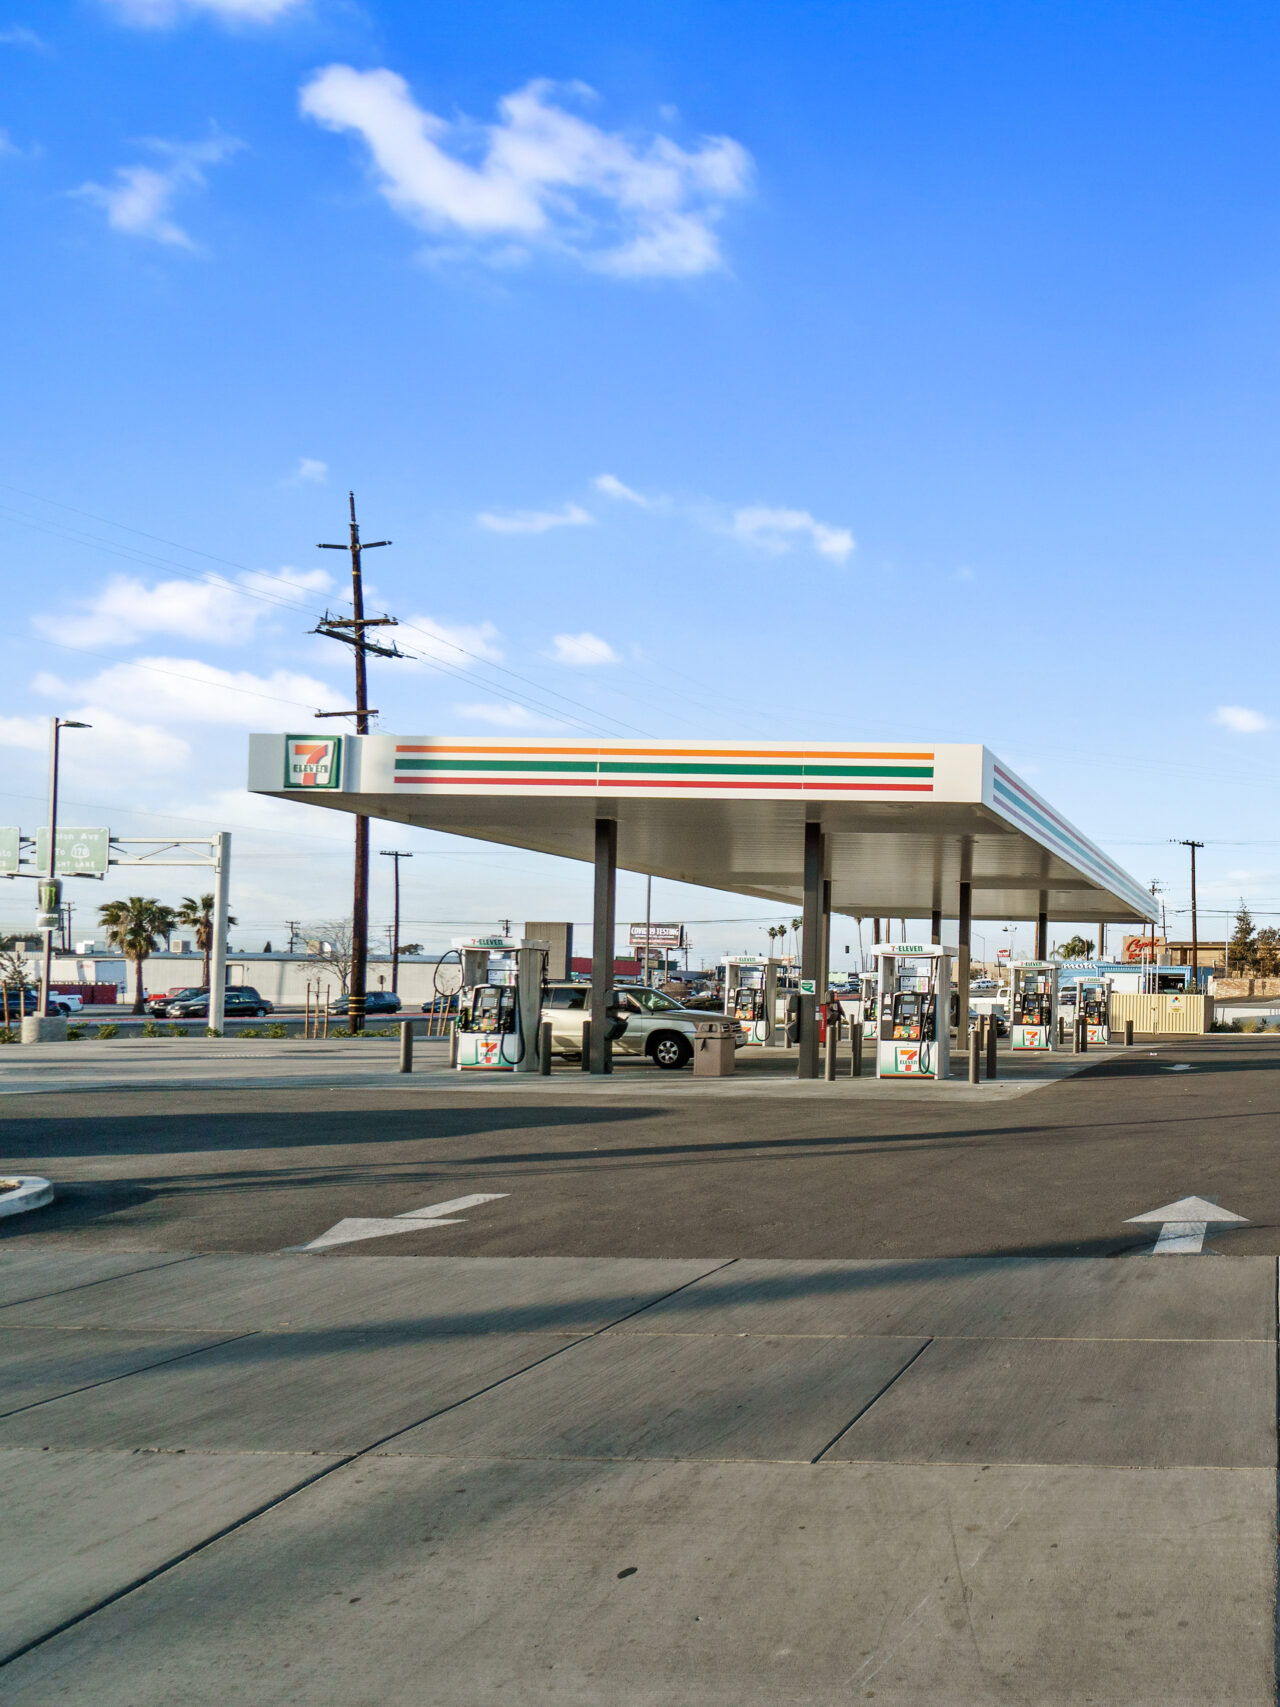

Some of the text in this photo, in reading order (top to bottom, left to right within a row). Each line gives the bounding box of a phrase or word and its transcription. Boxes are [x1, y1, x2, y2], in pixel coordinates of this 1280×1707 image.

[294, 744, 328, 785] 7
[1026, 1031, 1039, 1046] 7
[480, 1042, 497, 1064] 7
[900, 1049, 918, 1072] 7
